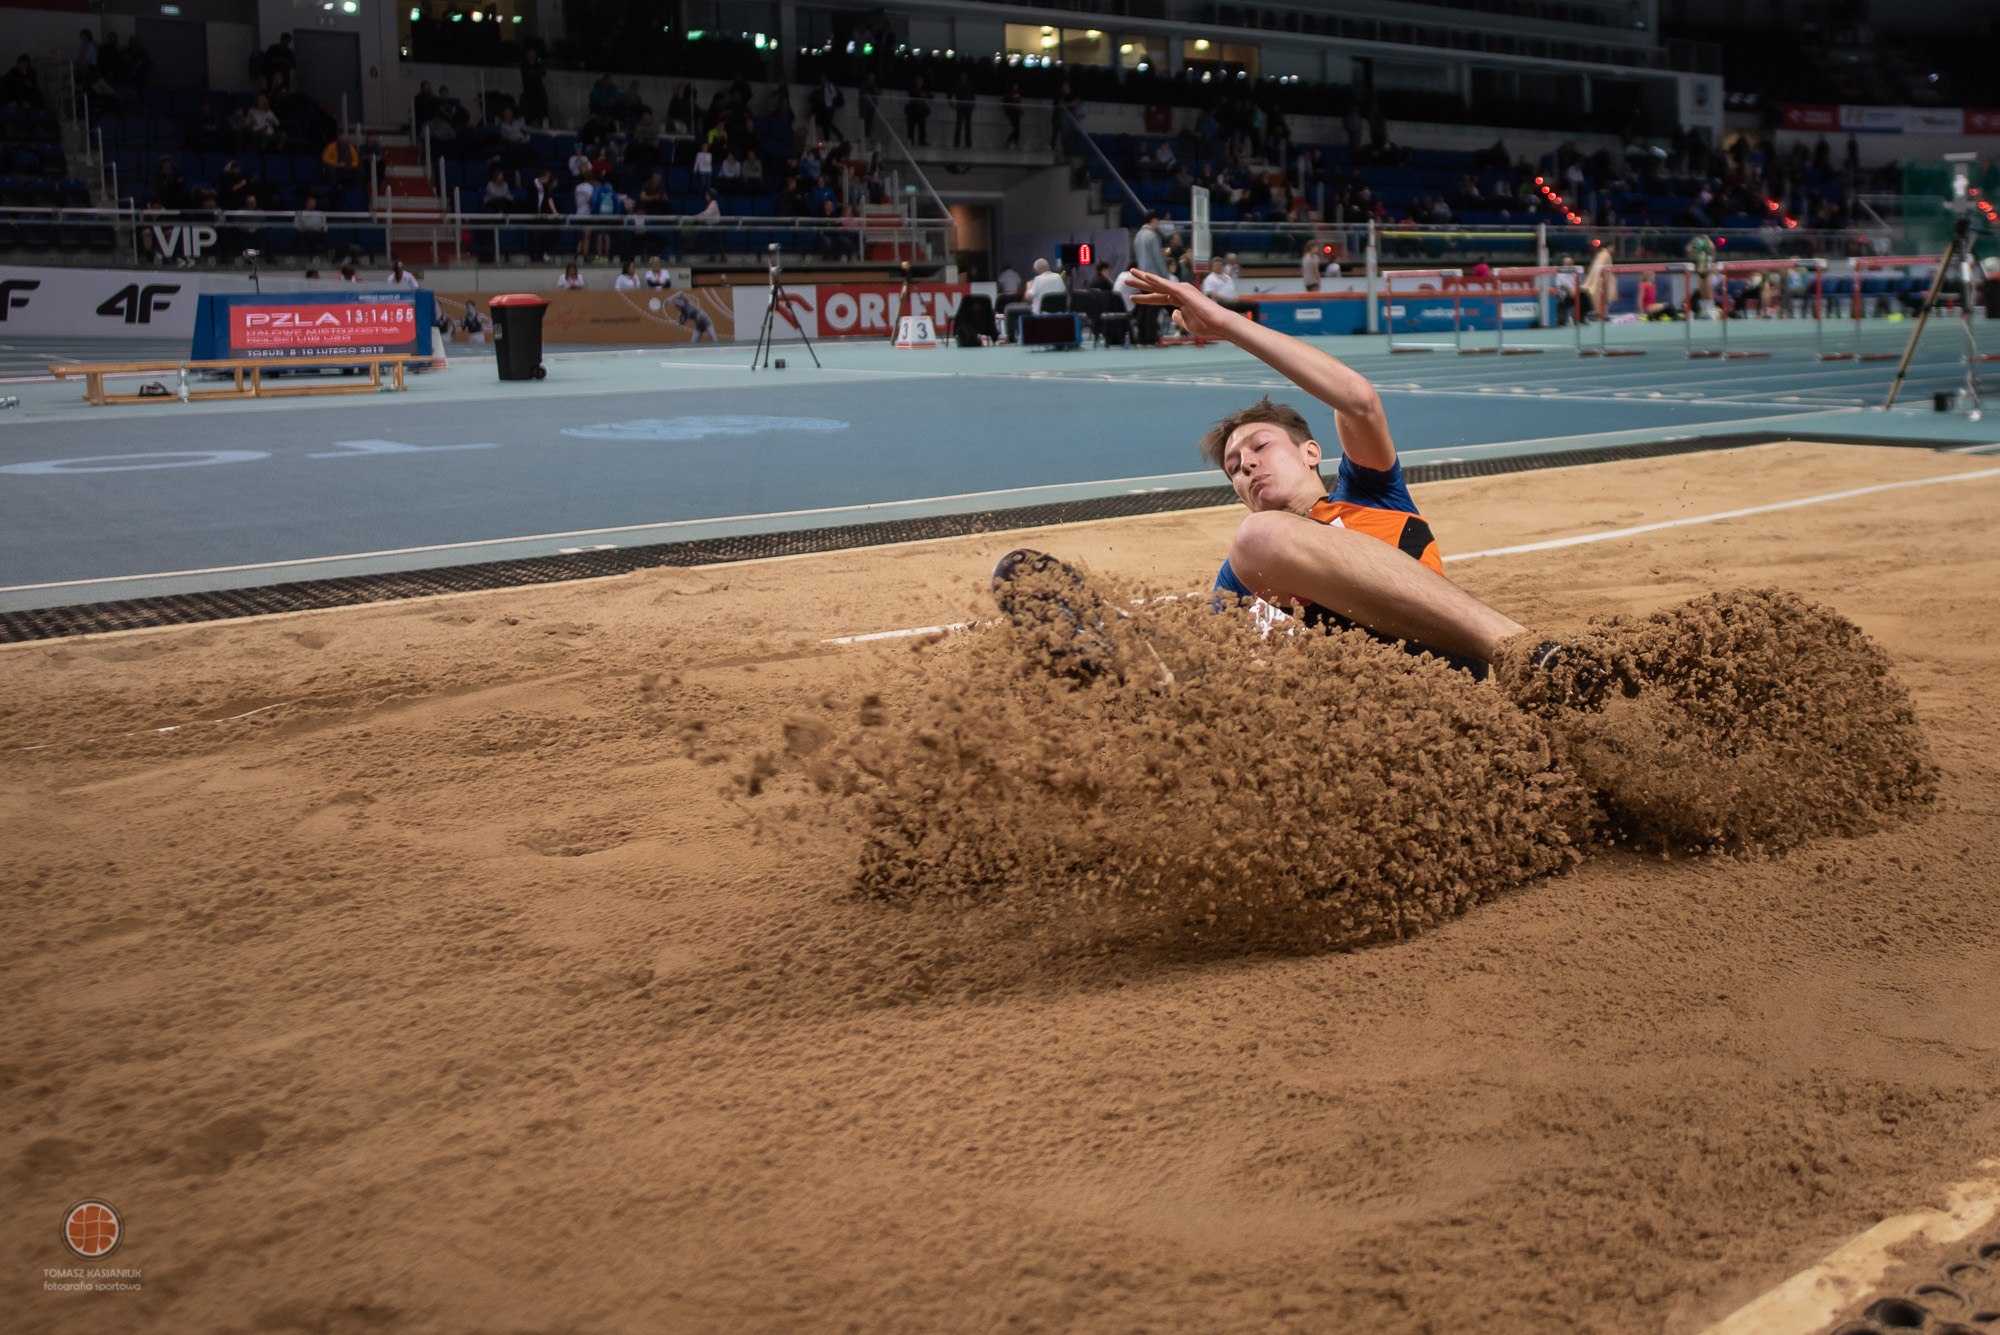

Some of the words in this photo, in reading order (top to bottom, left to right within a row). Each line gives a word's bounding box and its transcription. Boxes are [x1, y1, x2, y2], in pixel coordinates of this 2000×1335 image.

[153, 225, 217, 258] VIP
[1079, 244, 1091, 264] 0
[96, 284, 181, 324] 4F
[825, 292, 963, 331] ORLEN
[246, 312, 341, 328] PZLA
[902, 322, 909, 340] 3
[917, 322, 928, 340] 3
